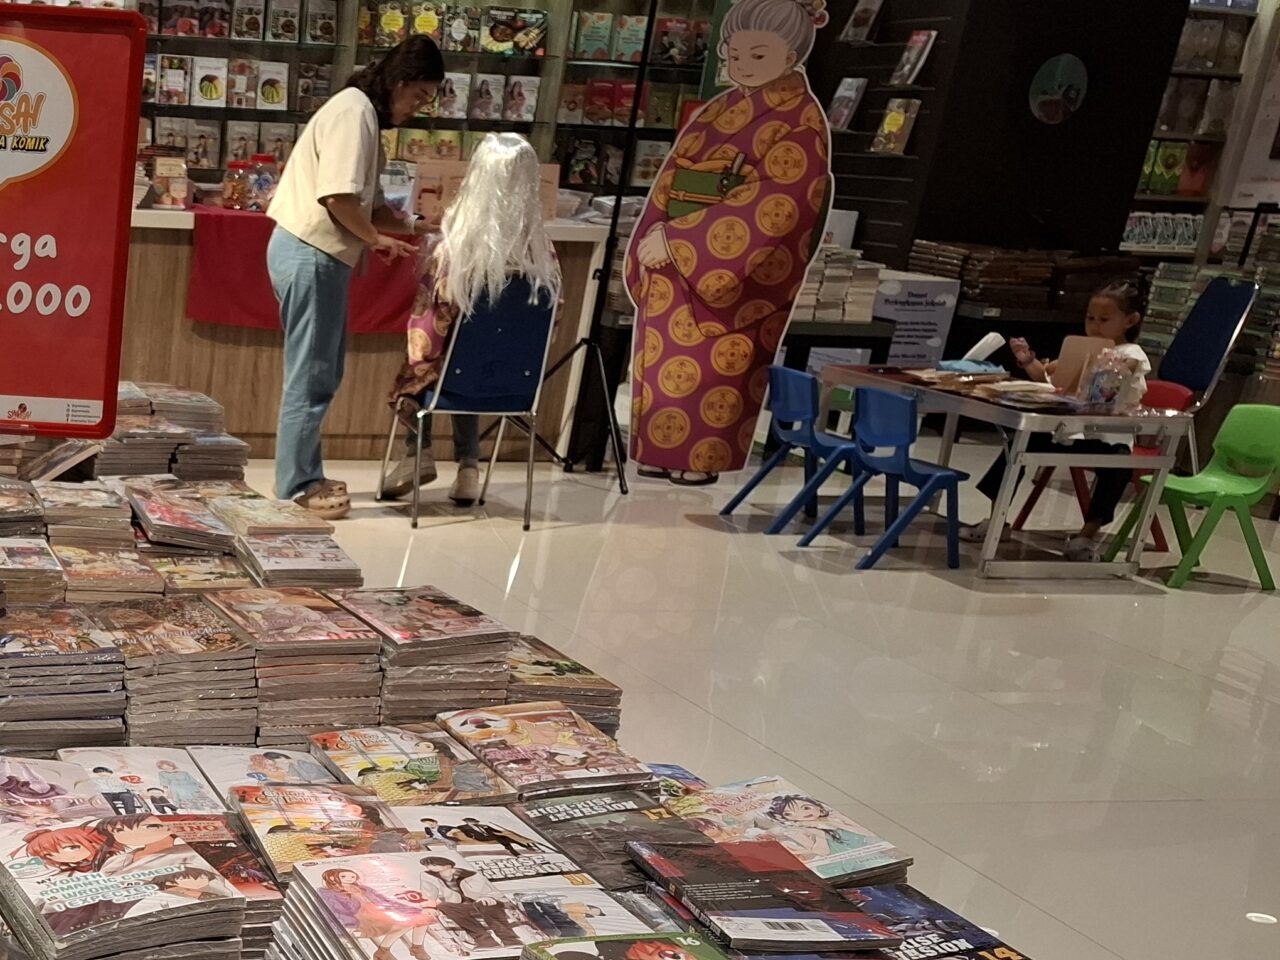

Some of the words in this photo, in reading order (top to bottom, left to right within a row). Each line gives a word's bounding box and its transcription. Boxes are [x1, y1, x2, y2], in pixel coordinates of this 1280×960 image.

[11, 136, 49, 151] KOMIK
[525, 797, 617, 818] HIGH-RISE
[548, 801, 639, 822] INVASION
[641, 808, 673, 821] 17
[39, 877, 118, 898] ROMANTIC
[121, 864, 187, 881] COMEDY
[51, 872, 103, 887] YOUTH
[66, 885, 158, 908] EXPECTED
[676, 936, 701, 947] 16
